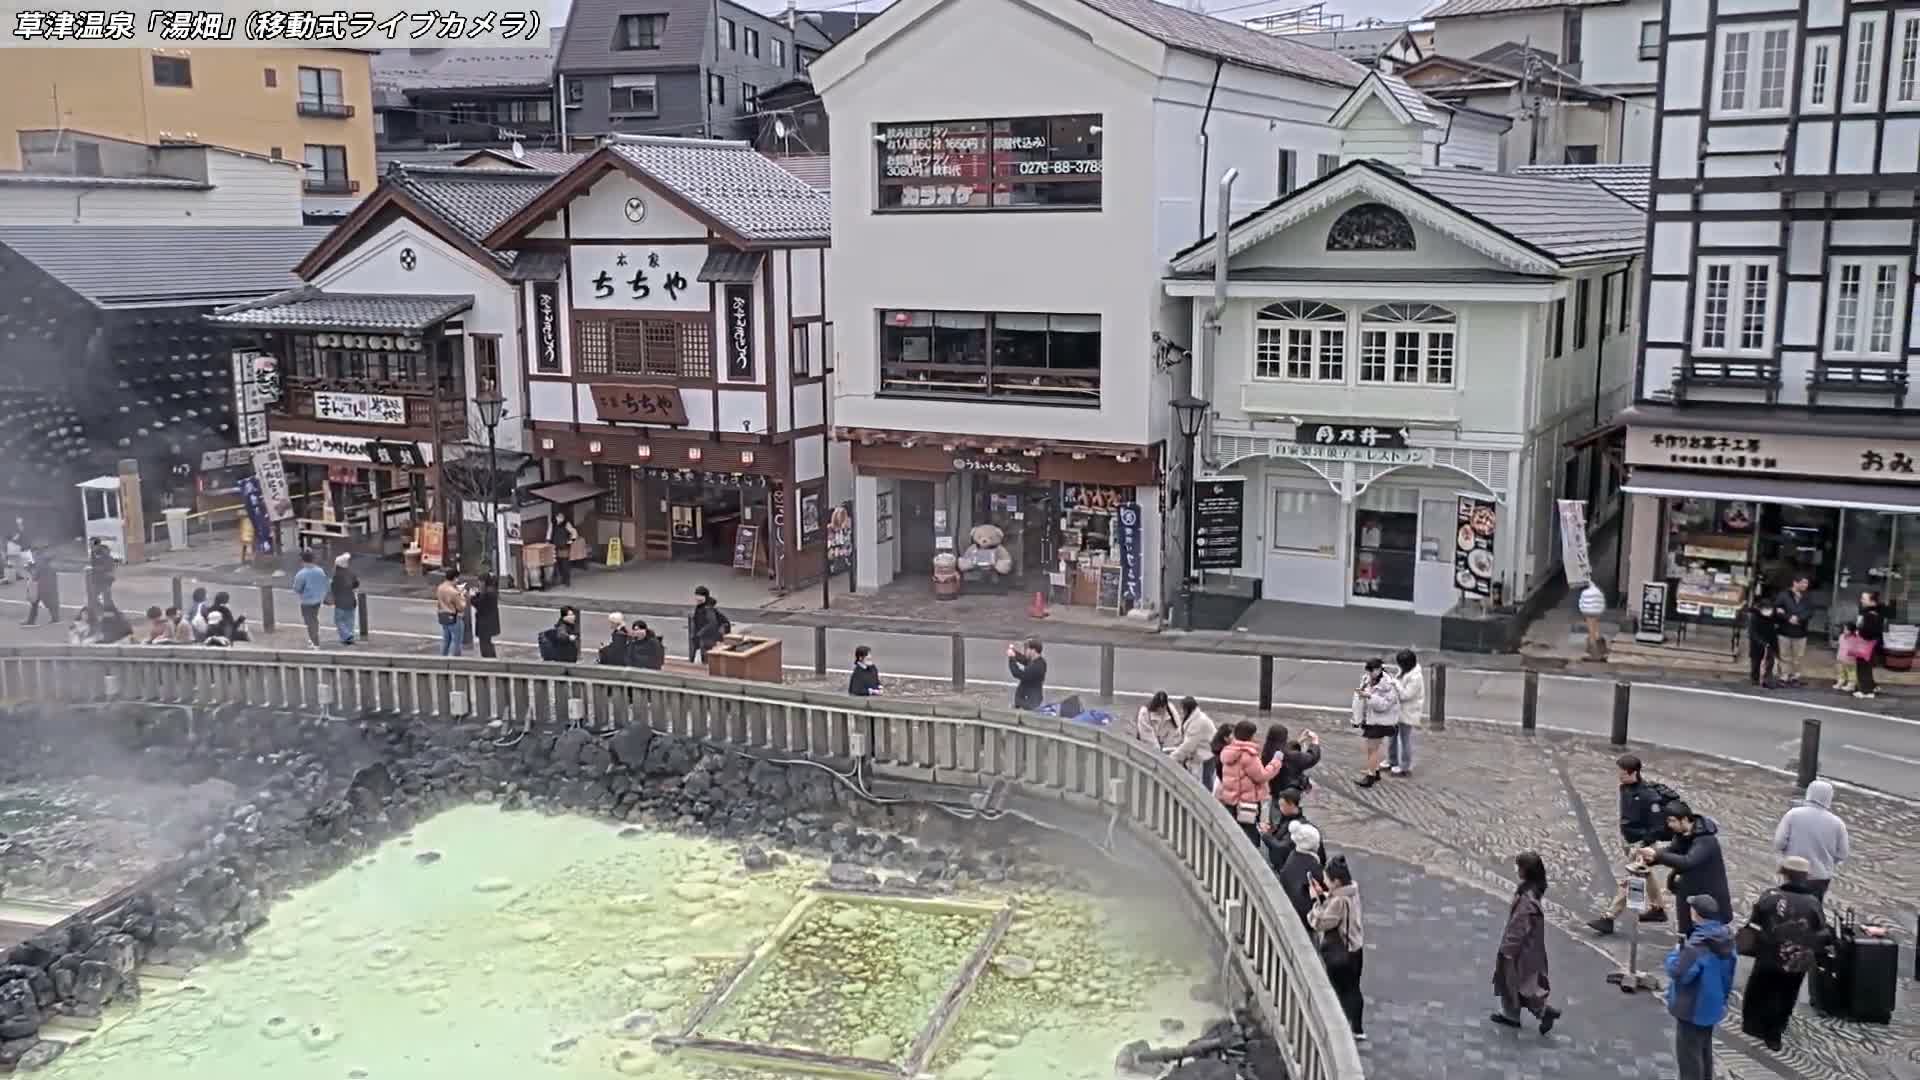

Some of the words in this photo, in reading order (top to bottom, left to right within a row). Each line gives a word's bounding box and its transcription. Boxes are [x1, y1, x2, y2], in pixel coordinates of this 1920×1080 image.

[901, 184, 974, 206] カラオケ
[616, 251, 660, 268] 本家
[592, 269, 688, 301] ちちや
[622, 392, 673, 417] ちちや
[1651, 433, 1761, 453] 手作りお菓子工房
[1861, 449, 1915, 473] おみ
